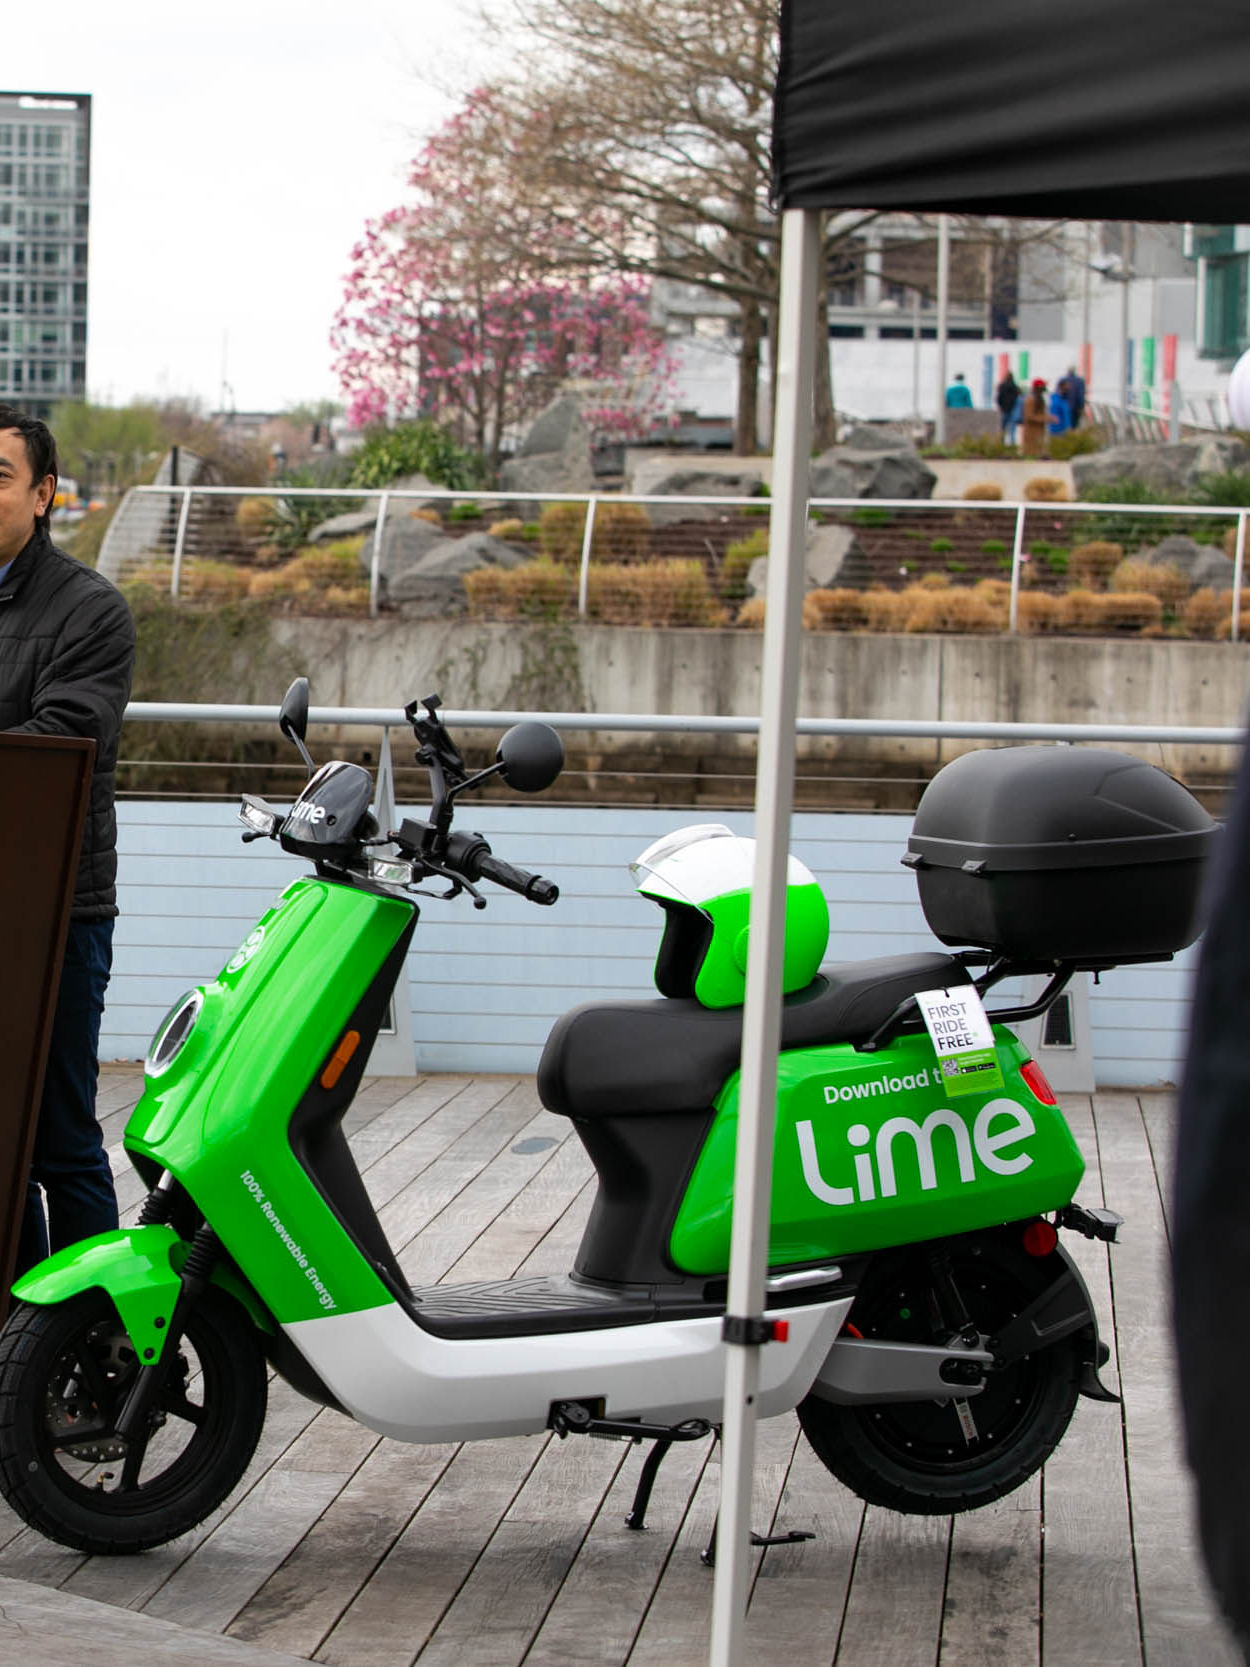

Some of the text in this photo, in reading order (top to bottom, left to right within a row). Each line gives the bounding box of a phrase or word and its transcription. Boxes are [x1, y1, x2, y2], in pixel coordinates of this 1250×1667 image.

[927, 1002, 967, 1020] FIRST
[933, 1018, 968, 1035] RIDE
[824, 1069, 930, 1105] Download
[932, 1070, 944, 1085] t
[795, 1098, 1036, 1206] Lime
[240, 1169, 337, 1310] 100% Renewable Energy
